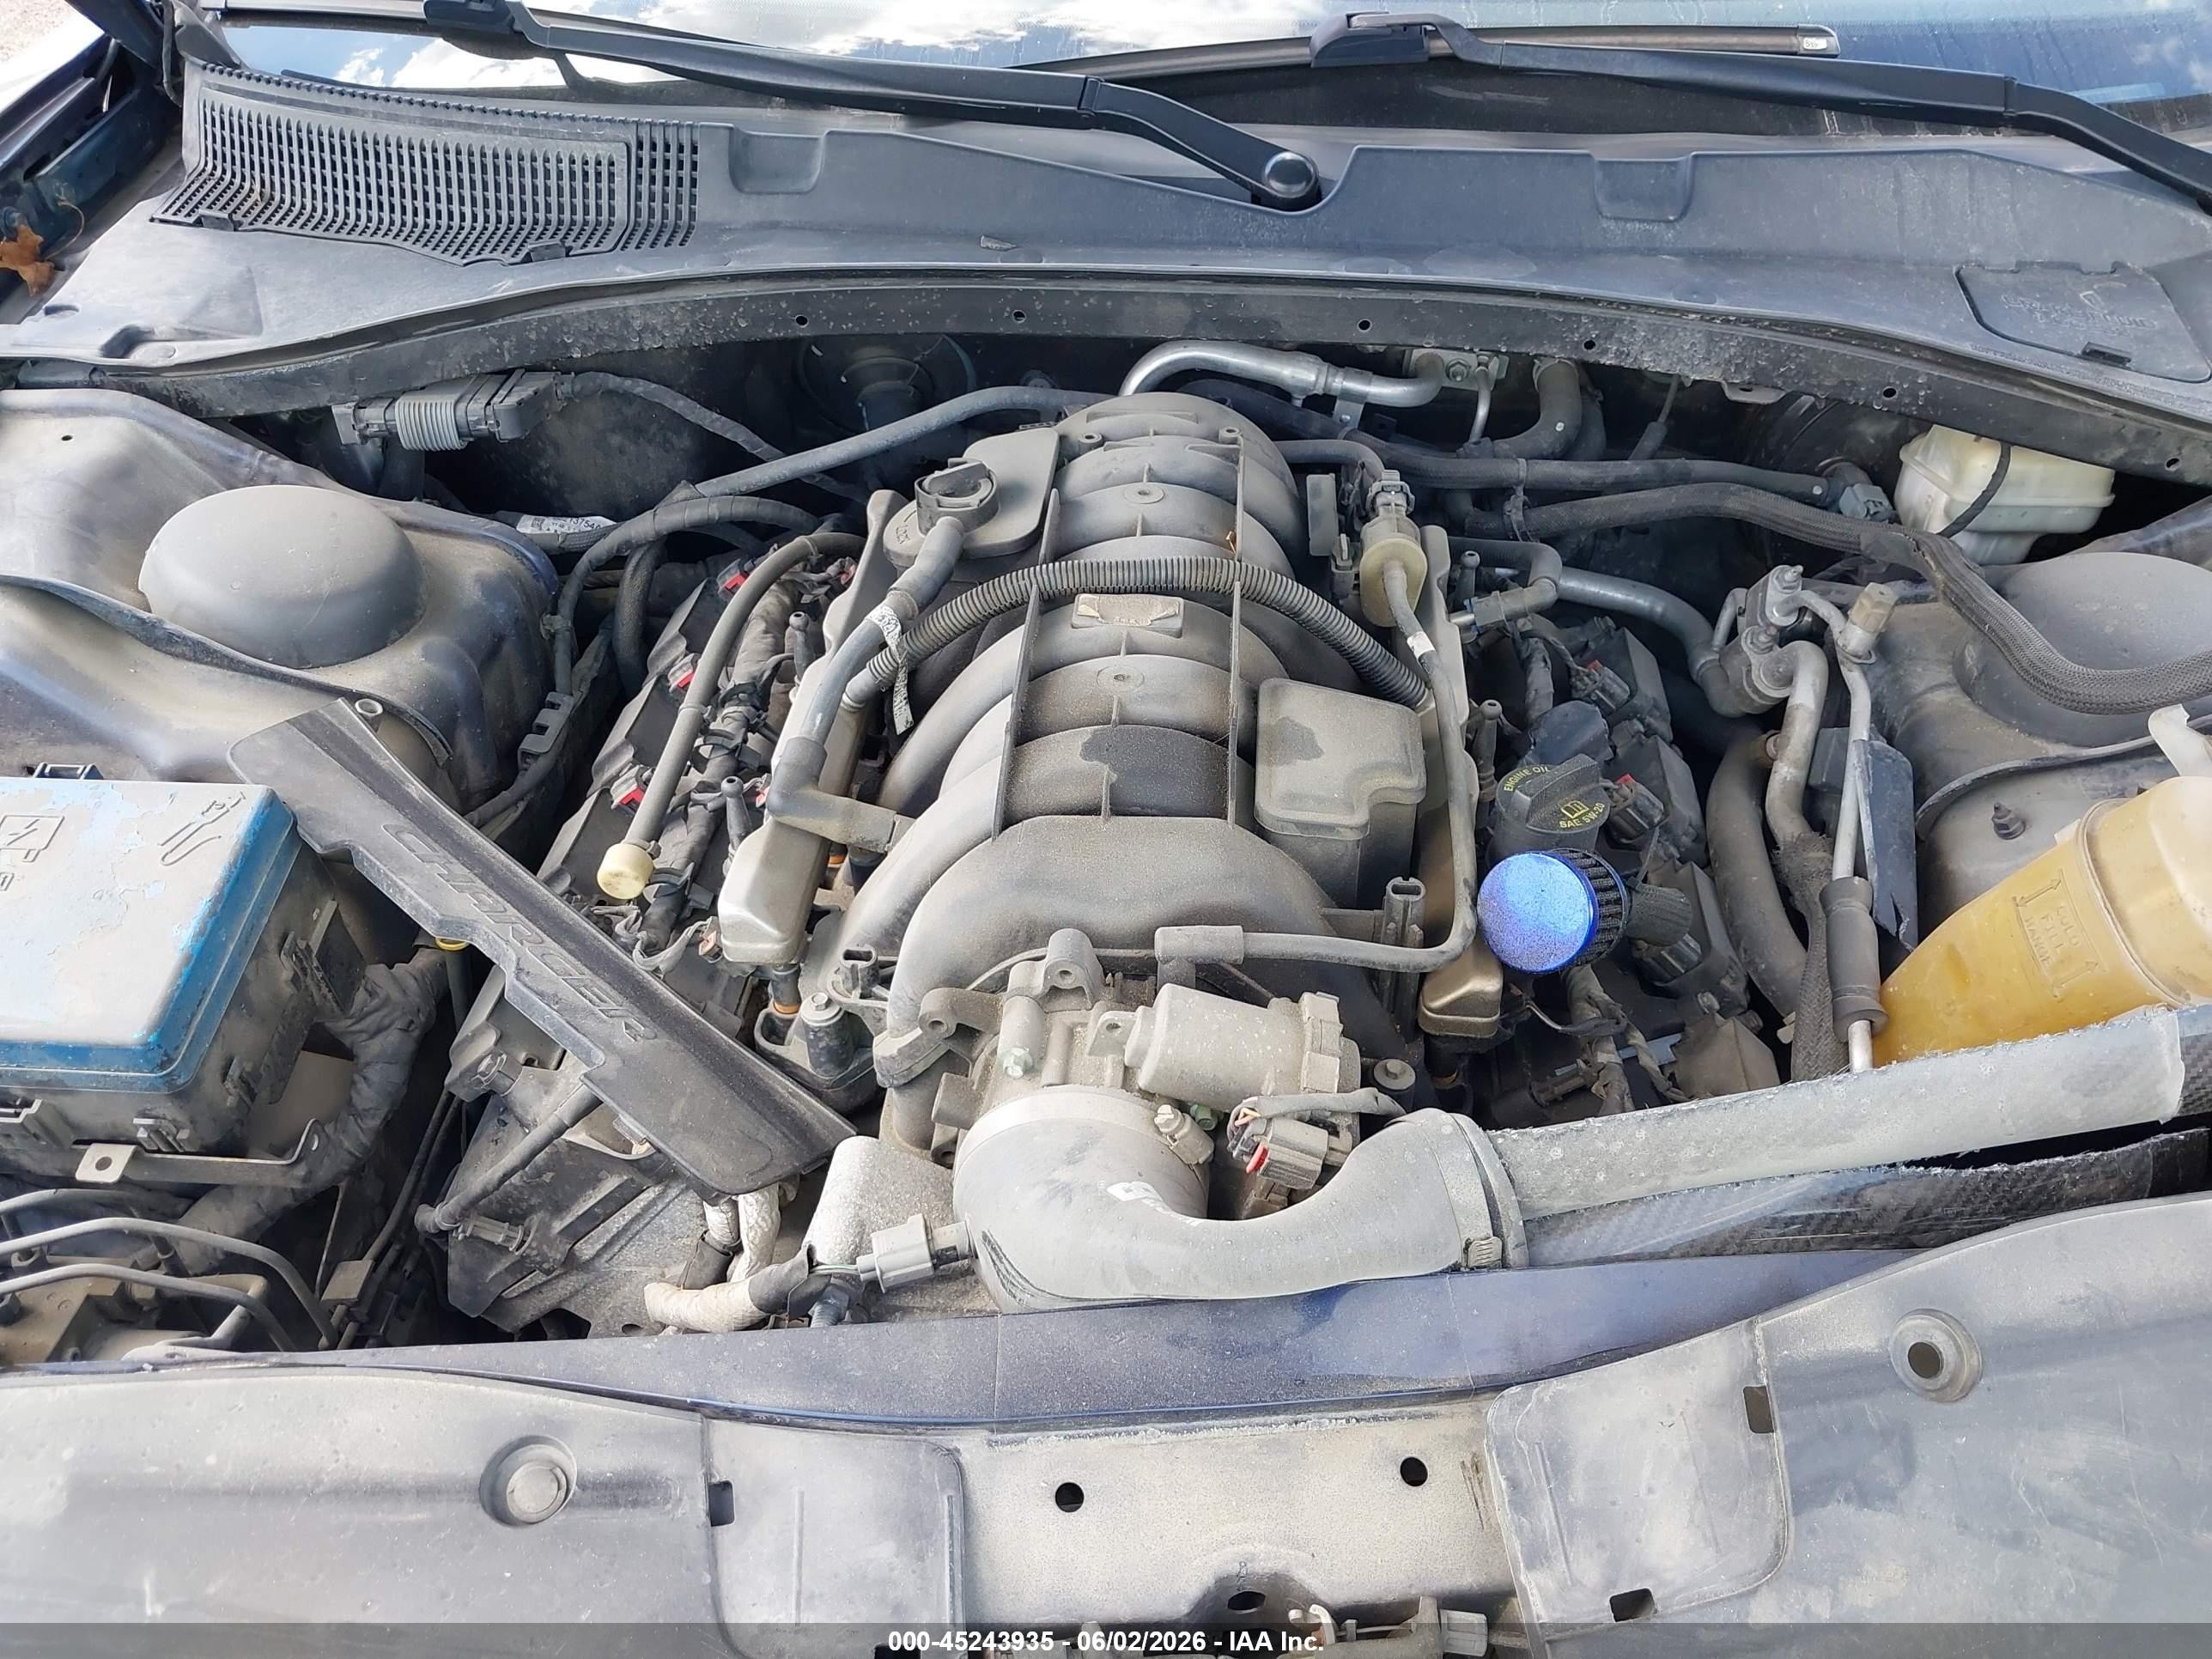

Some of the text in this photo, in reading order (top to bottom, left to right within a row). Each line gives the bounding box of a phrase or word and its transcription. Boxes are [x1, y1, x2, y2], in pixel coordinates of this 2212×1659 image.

[1504, 769, 1532, 792] ENGINE
[1559, 802, 1605, 829] SAE 5W-20
[380, 823, 657, 1042] CHARGER
